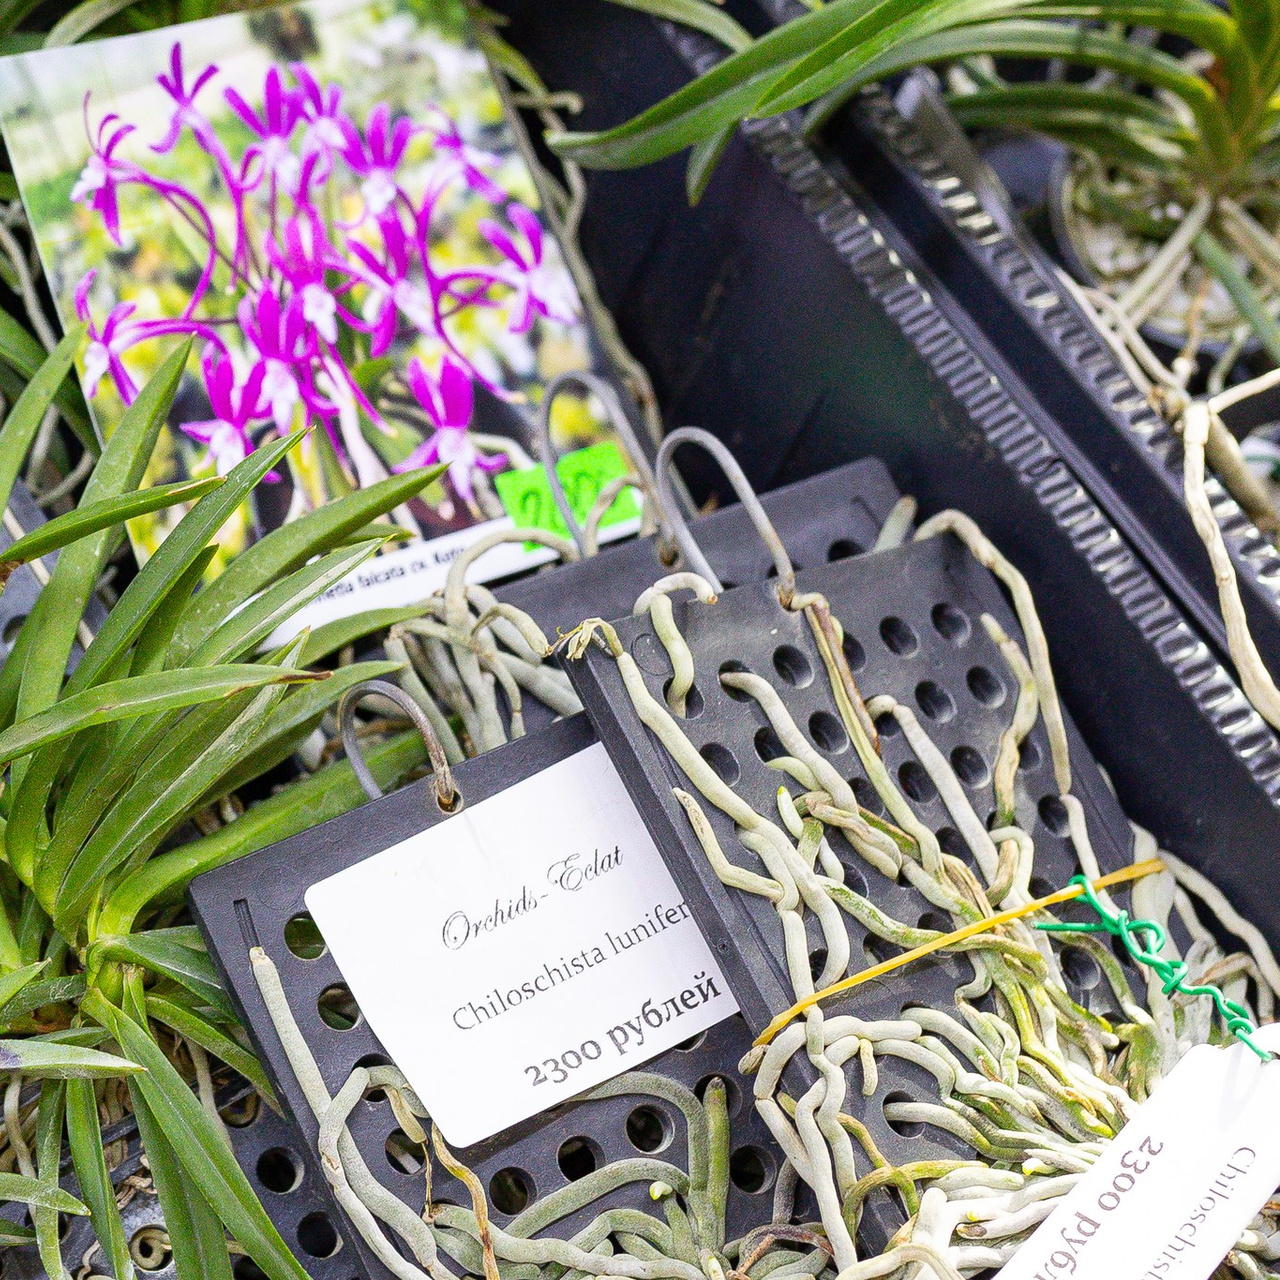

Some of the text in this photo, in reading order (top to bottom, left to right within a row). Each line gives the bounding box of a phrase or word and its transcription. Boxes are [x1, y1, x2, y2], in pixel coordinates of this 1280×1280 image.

[452, 945, 607, 1030] Chiloschista
[524, 971, 722, 1086] 2300 рублей
[1097, 1135, 1163, 1211] 2300
